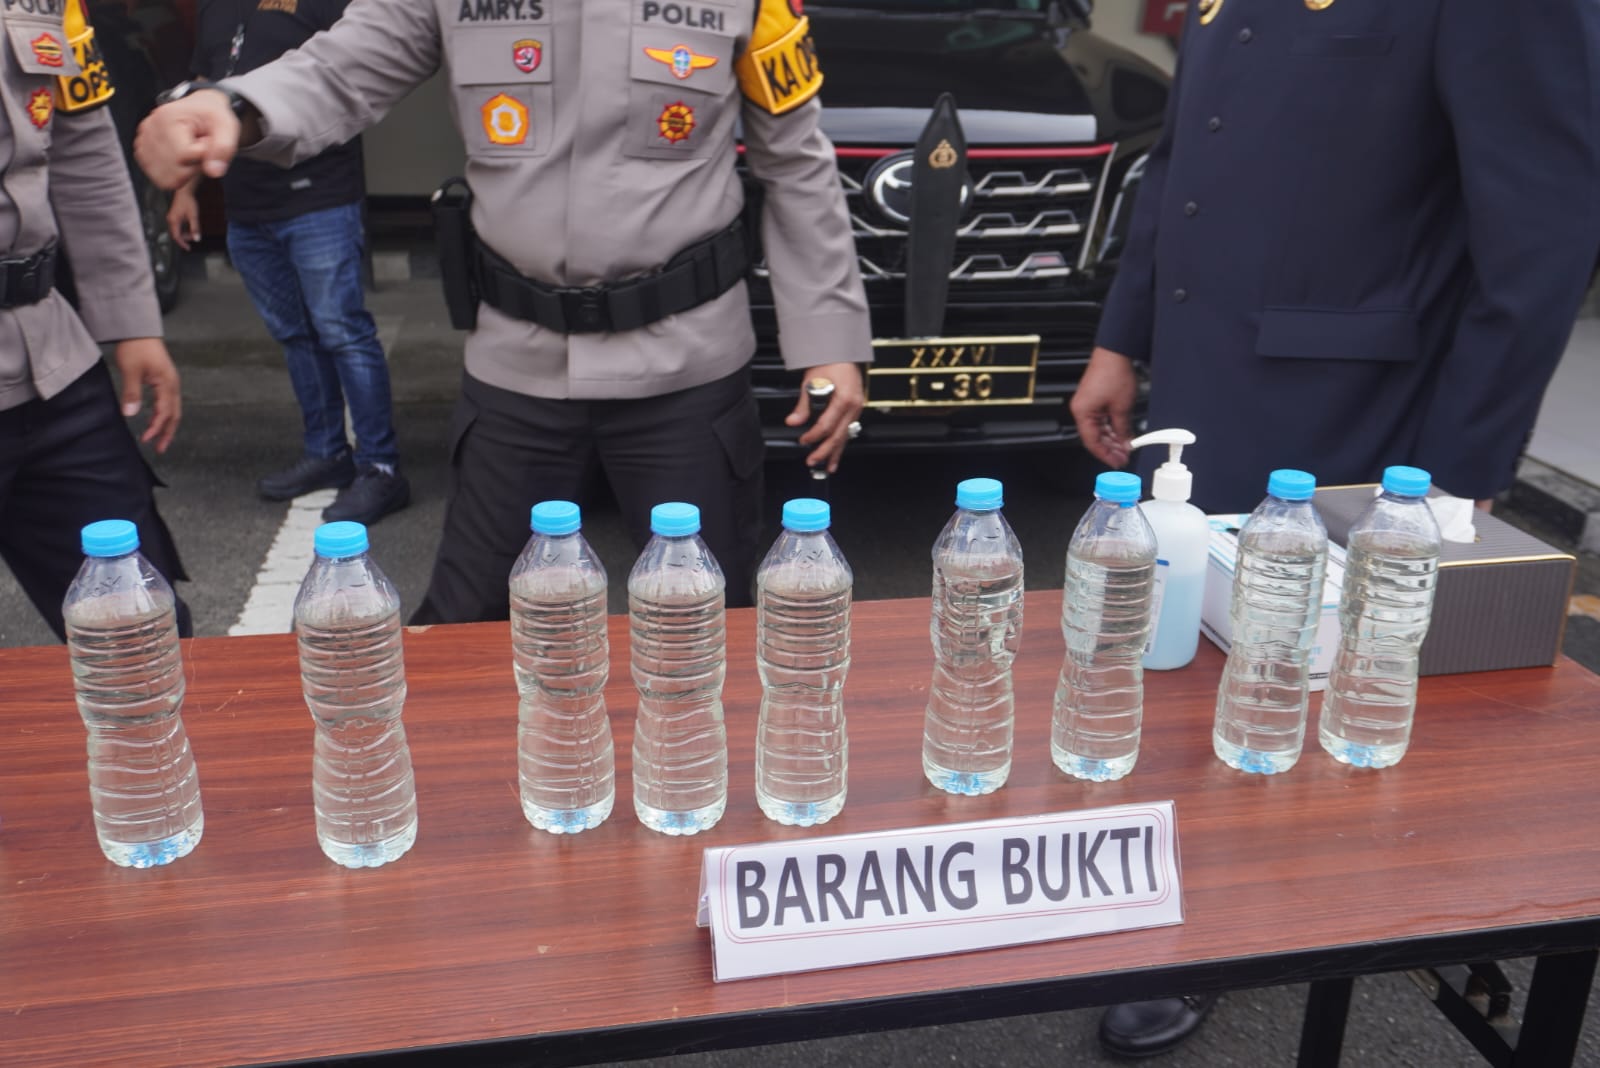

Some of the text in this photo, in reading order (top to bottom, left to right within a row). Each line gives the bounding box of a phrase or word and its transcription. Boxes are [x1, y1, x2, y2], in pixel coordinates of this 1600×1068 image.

[643, 0, 725, 32] POLRI
[761, 51, 803, 104] KA
[736, 826, 1158, 930] BARANG BUKTI
